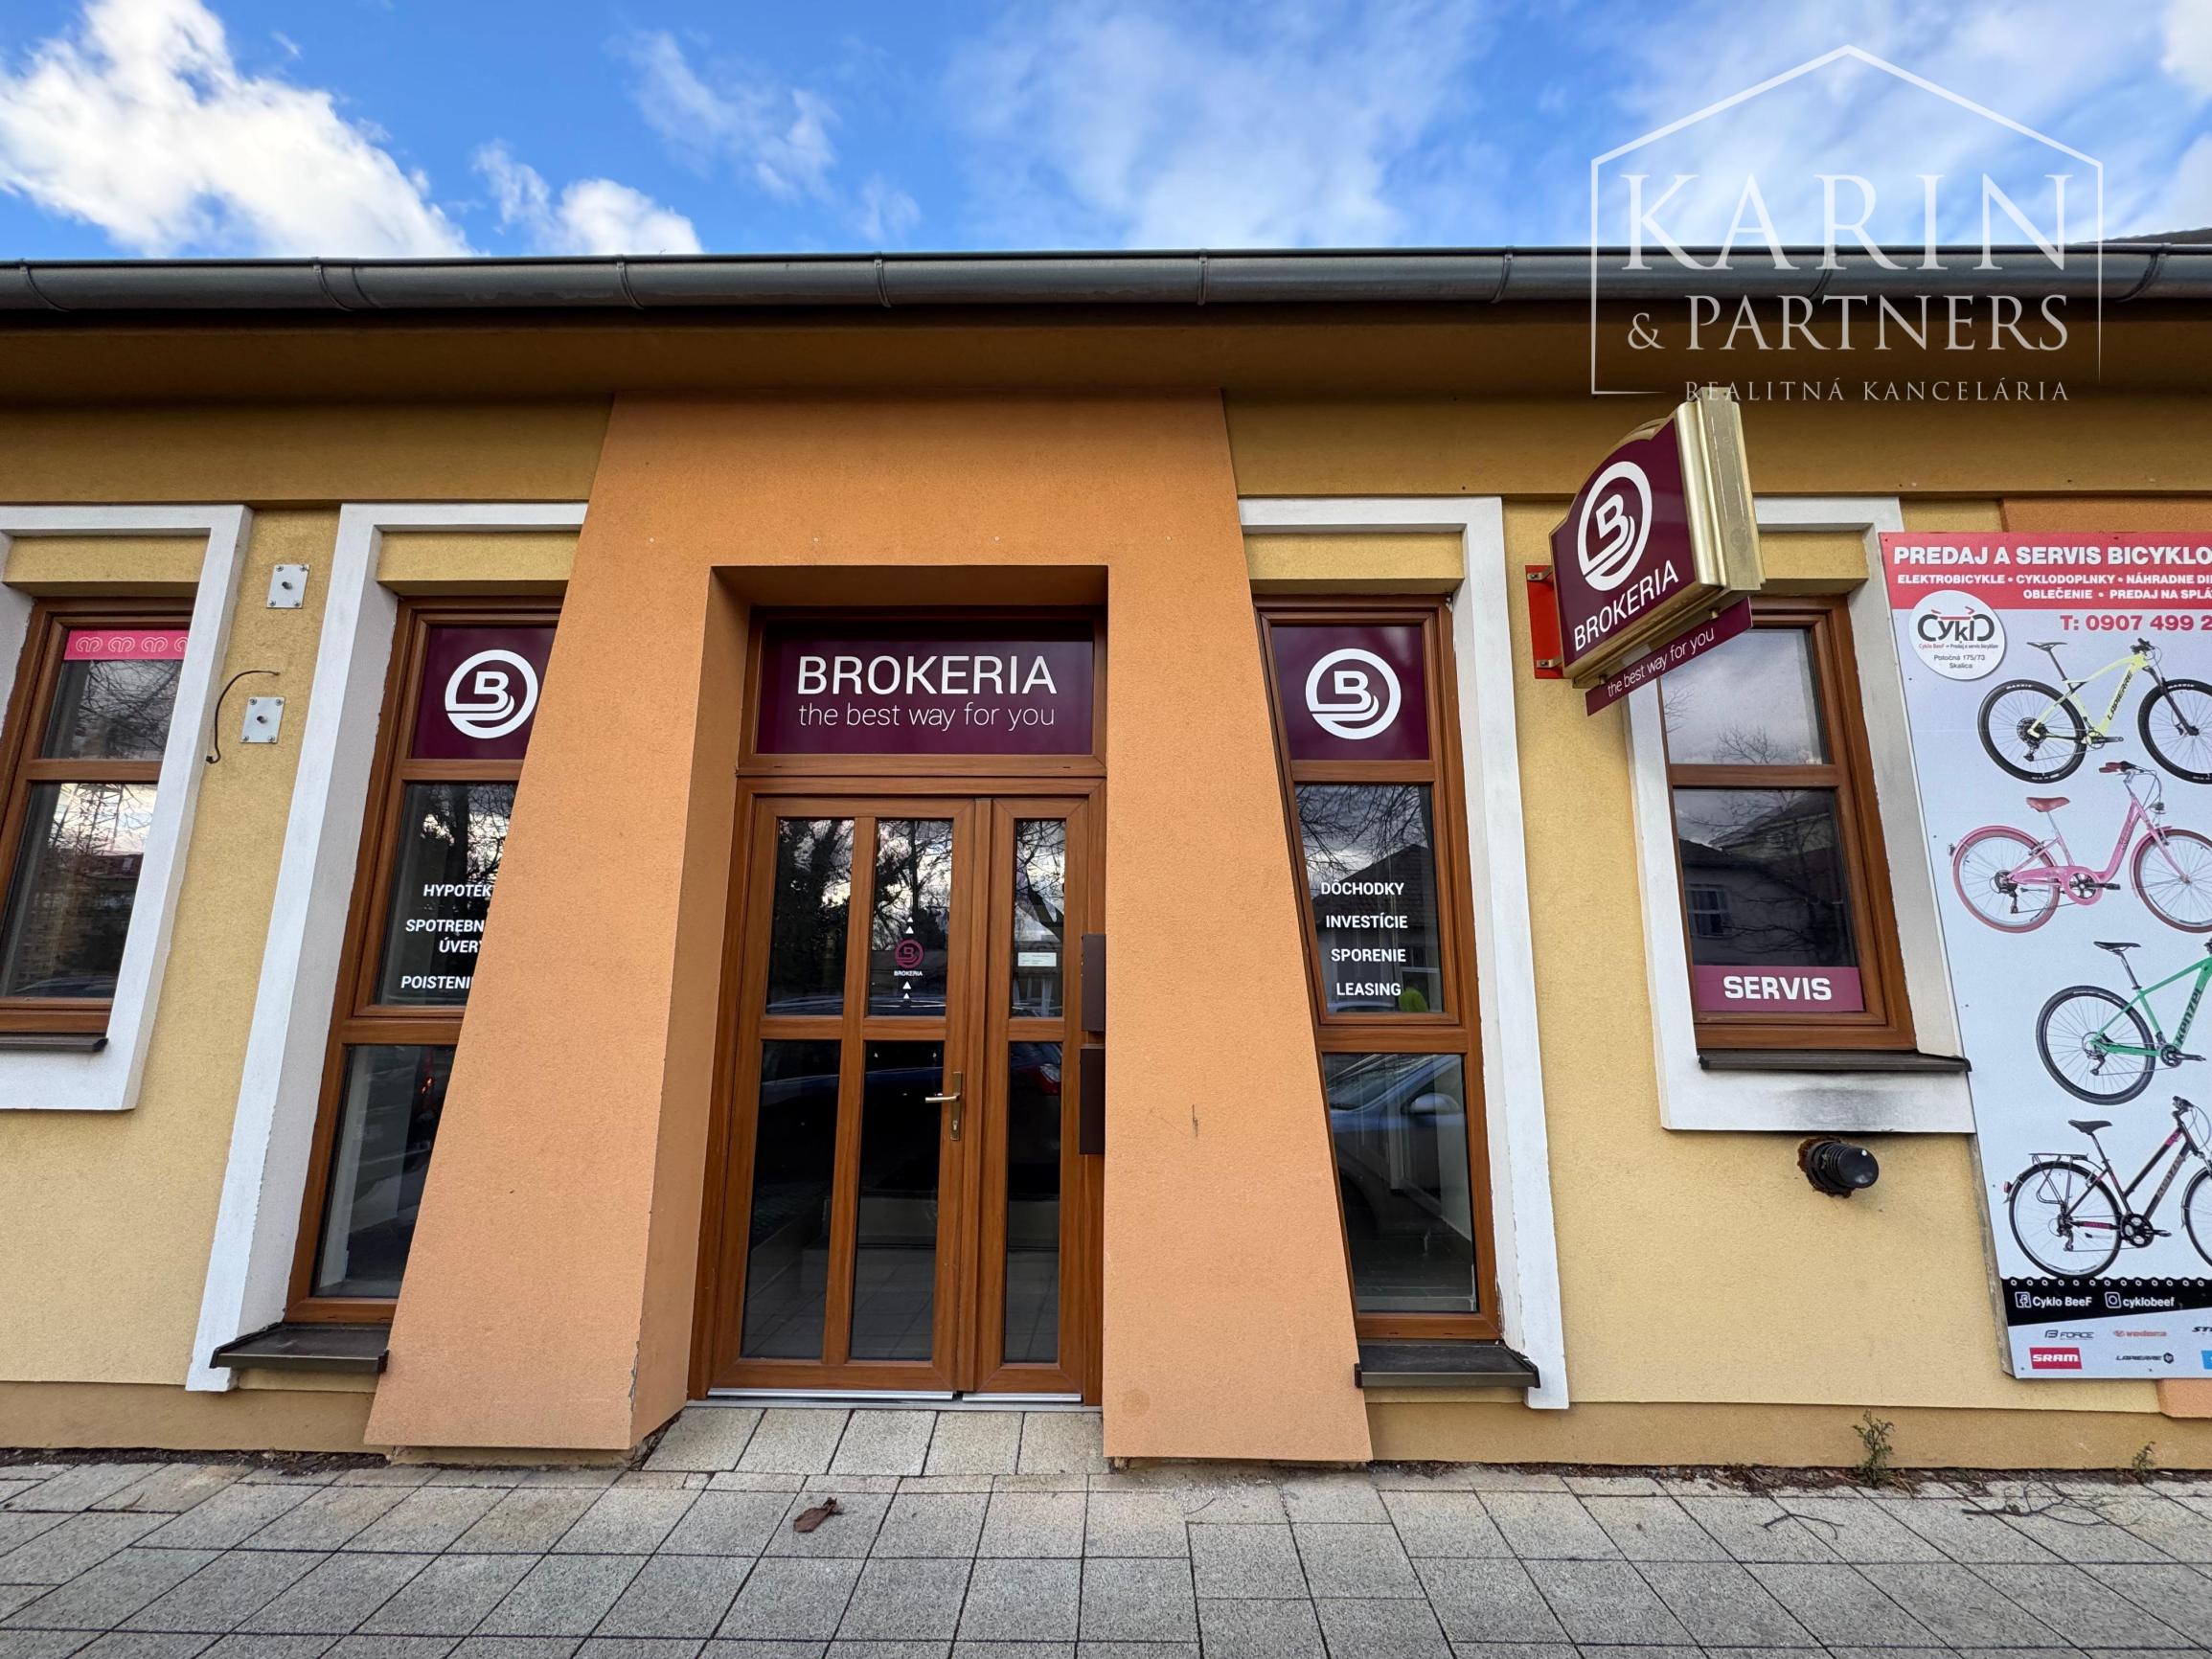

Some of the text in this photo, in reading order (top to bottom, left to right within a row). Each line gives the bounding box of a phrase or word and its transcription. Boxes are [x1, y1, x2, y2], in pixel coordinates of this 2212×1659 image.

[1894, 546, 1988, 565] PREDAJ
[1994, 546, 2011, 565] A
[2016, 546, 2102, 565] SERVIS
[1898, 574, 2005, 584] ELEKTROBICYKLE
[2016, 574, 2115, 584] CYKLODOPLNKY
[2126, 572, 2195, 584] NÁHRADNE
[2023, 585, 2212, 600] OBLEČENIE PREDAJ NA SPLÁ
[1574, 559, 1679, 652] BROKERIA
[2060, 615, 2080, 631] T:
[2086, 615, 2143, 631] 0907
[2150, 615, 2195, 631] 499
[1608, 628, 1715, 697] the best way for you
[797, 655, 1058, 695] BROKERIA
[798, 702, 1055, 732] the best way for you
[1321, 879, 1404, 896] DÔCHODKY
[405, 919, 485, 932] SPOTREBN
[1326, 912, 1408, 928] INVESTÍCIE
[439, 937, 482, 953] ÚVER
[1331, 948, 1406, 963] SPORENIE
[400, 975, 472, 989] POISTENI
[1336, 982, 1402, 996] LEASING
[1722, 975, 1833, 1001] SERVIS
[2032, 1296, 2093, 1308] Cyklo BeeF
[2122, 1296, 2176, 1308] cyklobeef
[2032, 1353, 2079, 1362] SRAM
